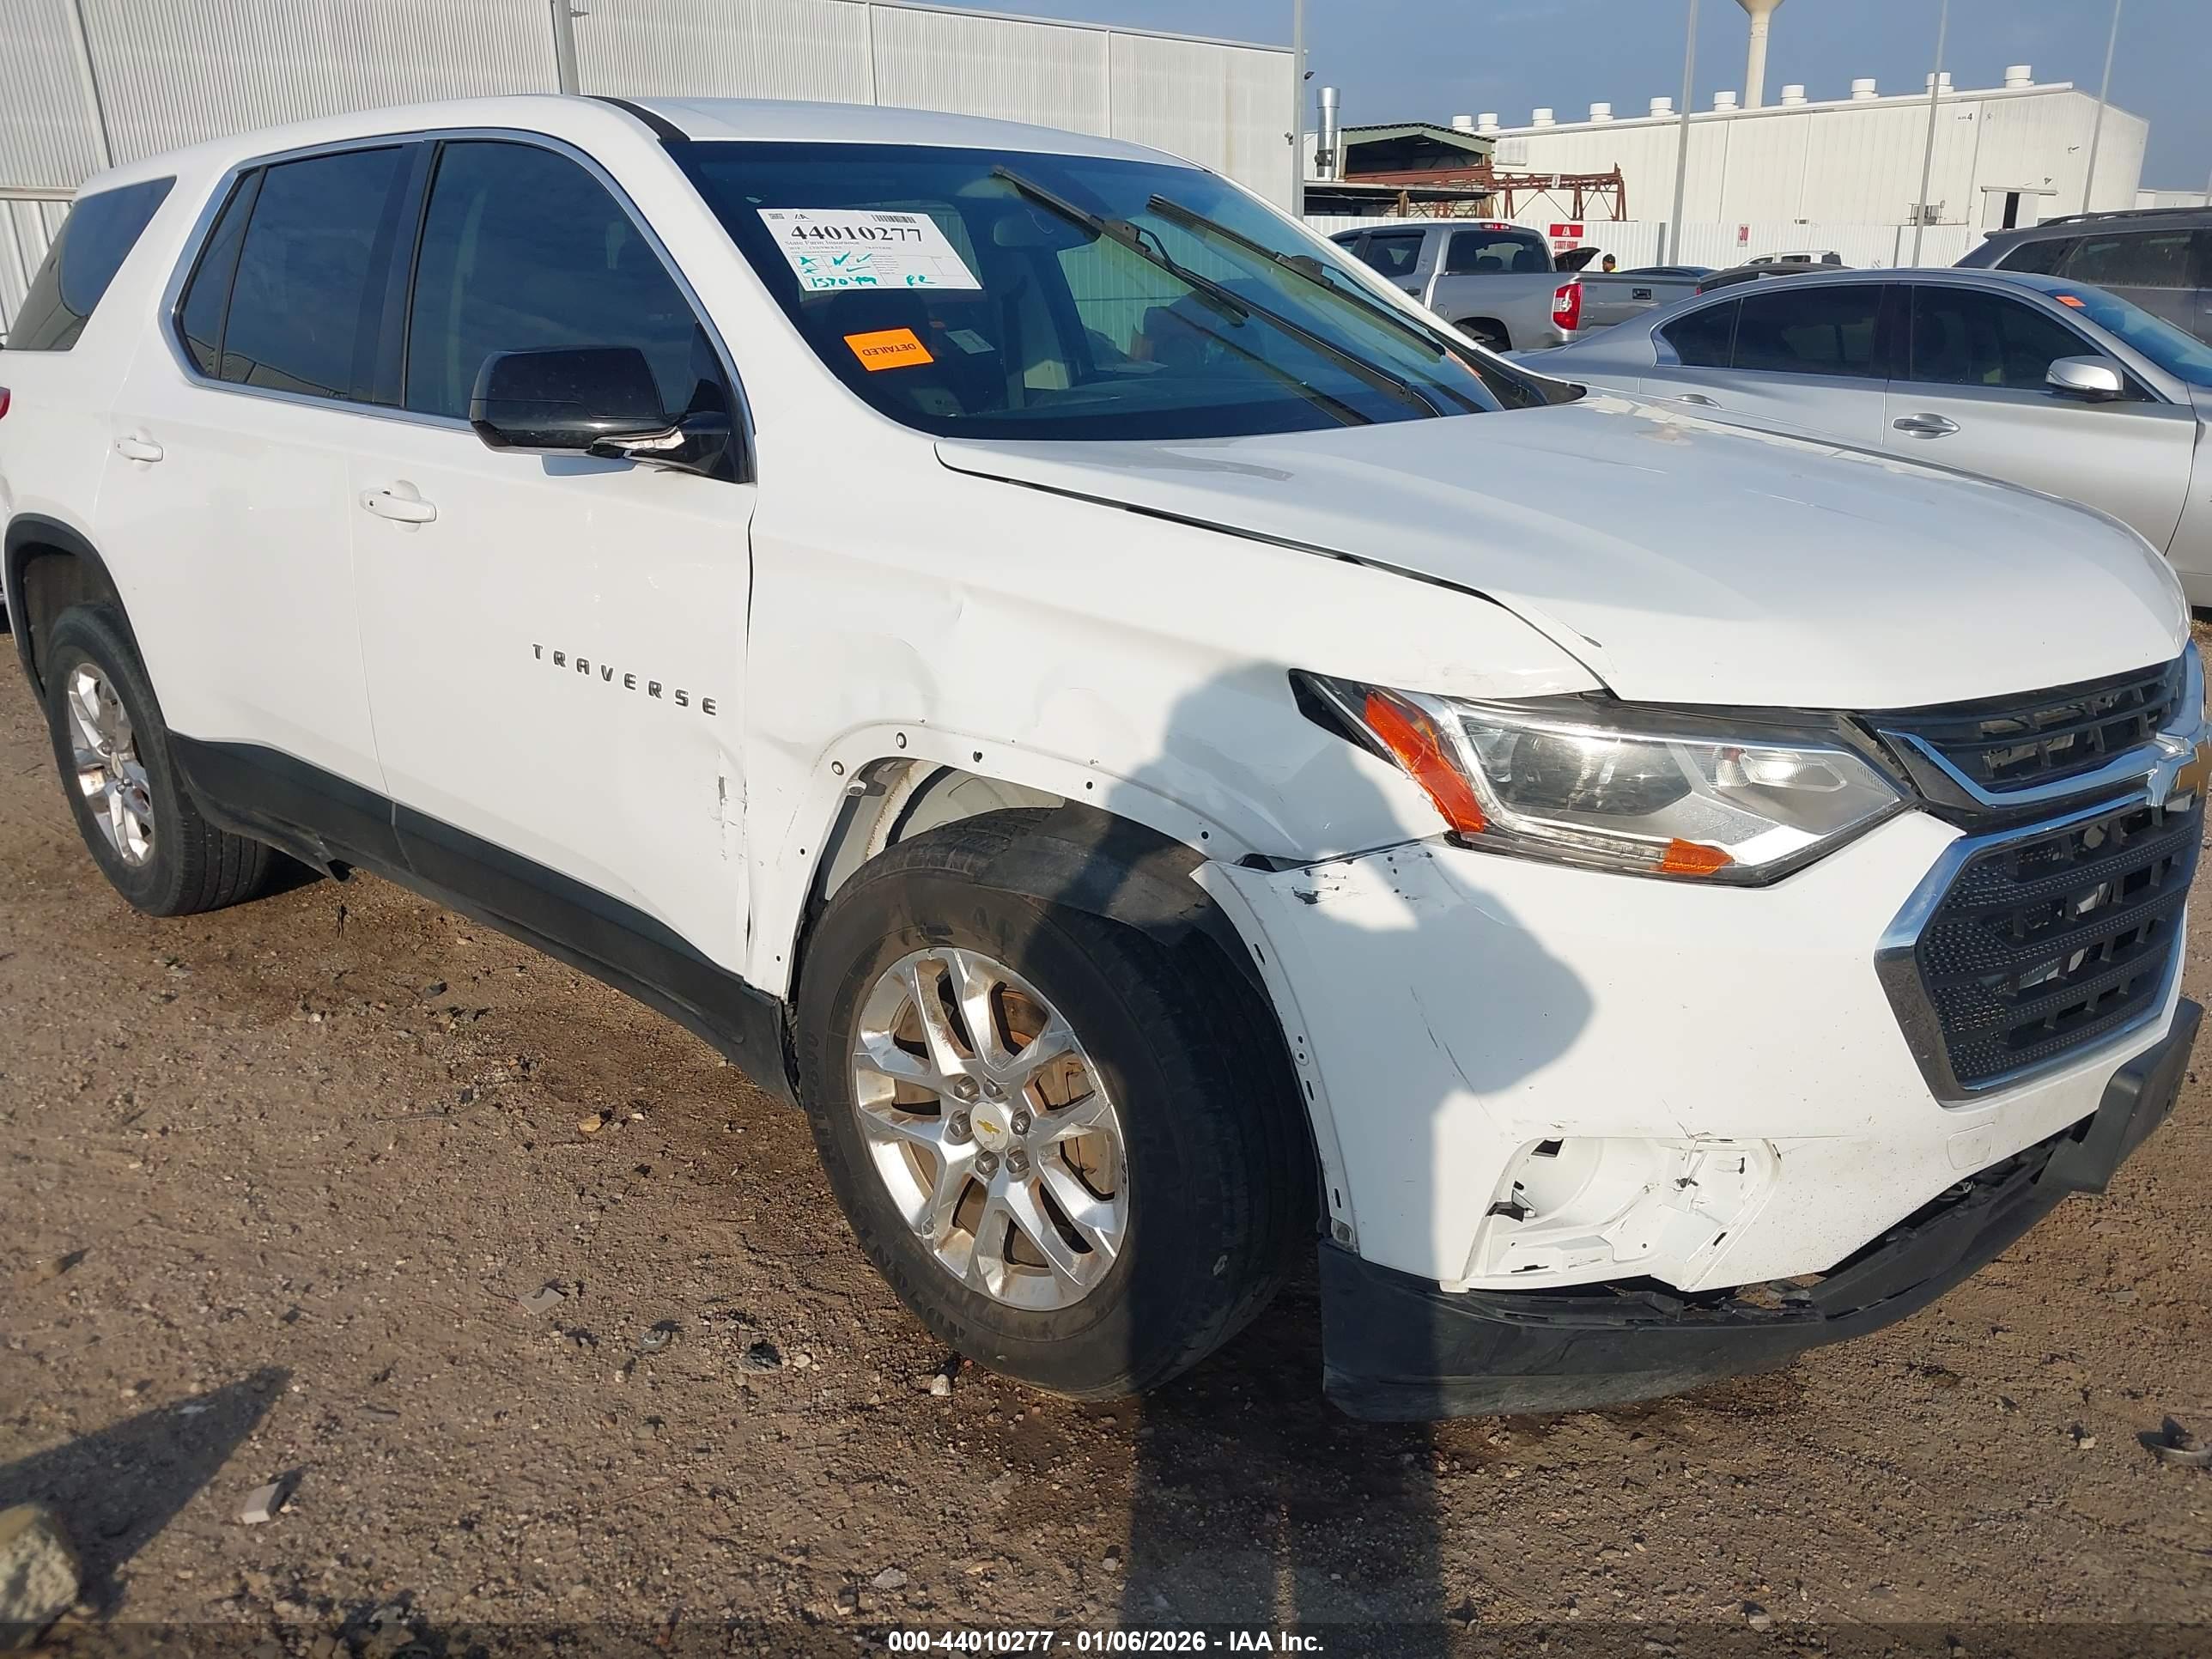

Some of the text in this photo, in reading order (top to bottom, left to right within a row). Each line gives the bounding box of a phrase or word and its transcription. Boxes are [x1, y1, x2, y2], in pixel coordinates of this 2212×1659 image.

[1966, 112, 1972, 121] 4
[791, 225, 922, 242] 44010277
[1739, 226, 1749, 241] 30
[862, 343, 917, 356] DETAILED
[532, 643, 717, 716] TRAVERSE
